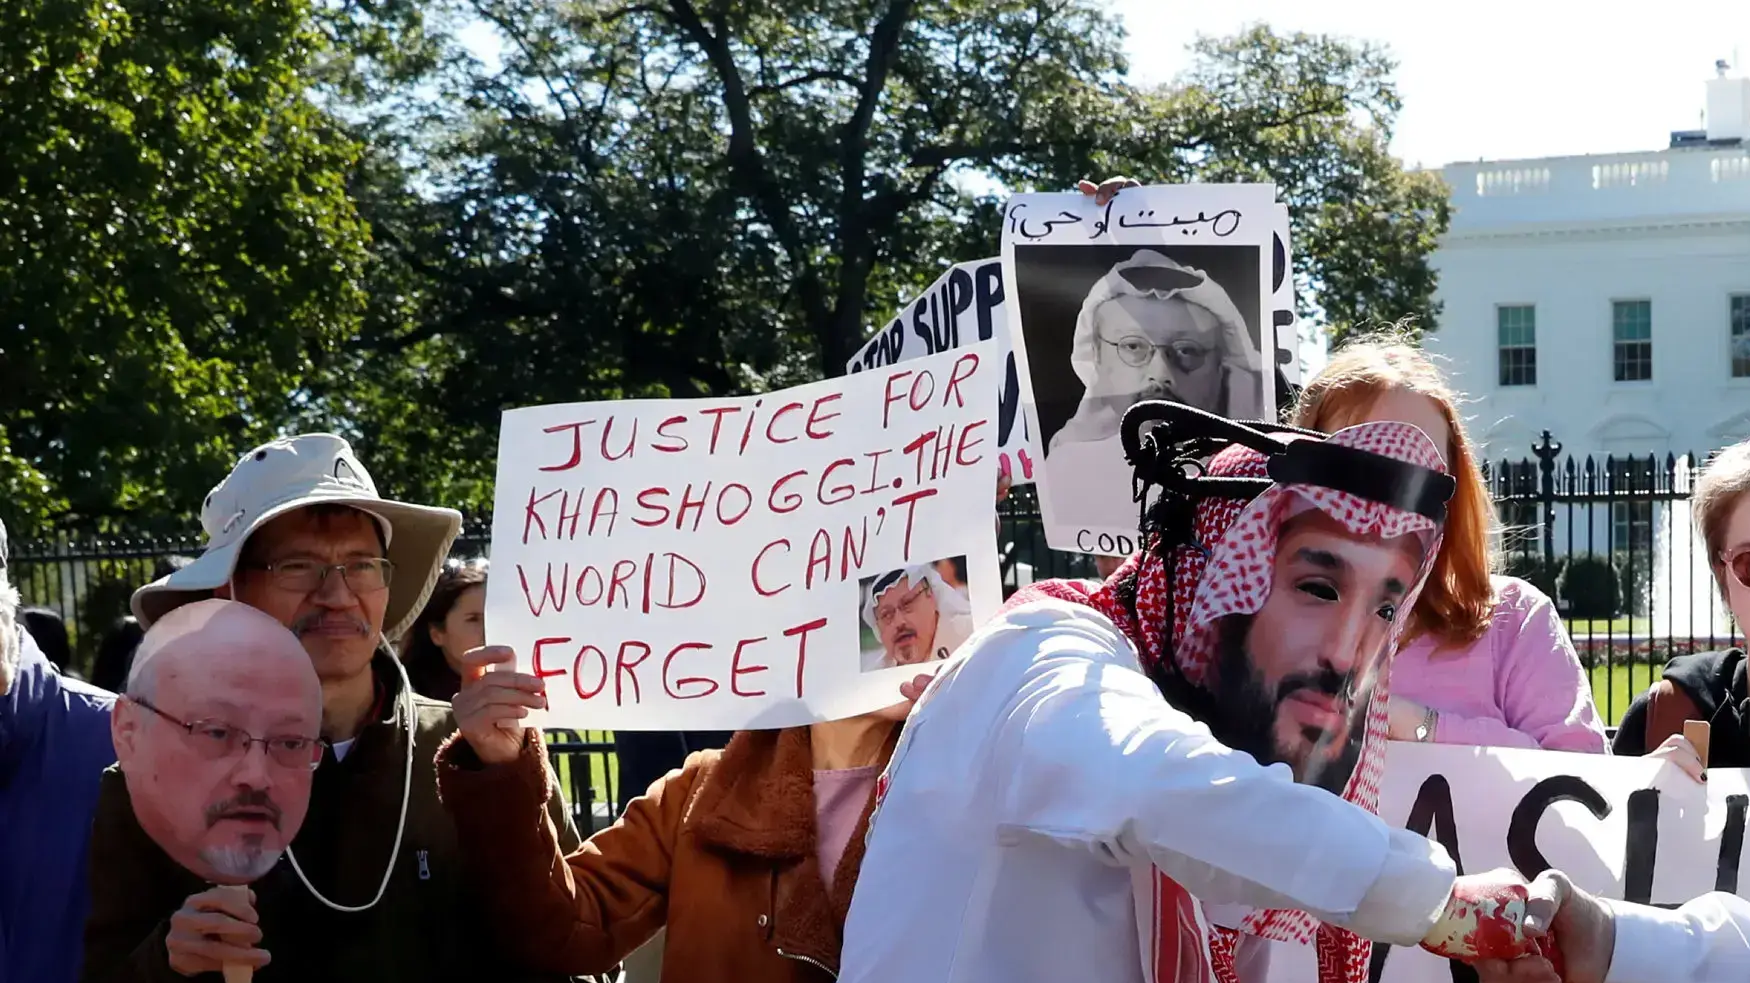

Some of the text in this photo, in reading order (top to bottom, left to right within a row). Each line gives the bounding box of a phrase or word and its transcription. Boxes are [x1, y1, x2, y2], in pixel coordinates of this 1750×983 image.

[538, 393, 842, 472] JUSTICE
[883, 353, 980, 429] FOR
[751, 487, 938, 596] CAN'T
[532, 617, 827, 711] FORGET
